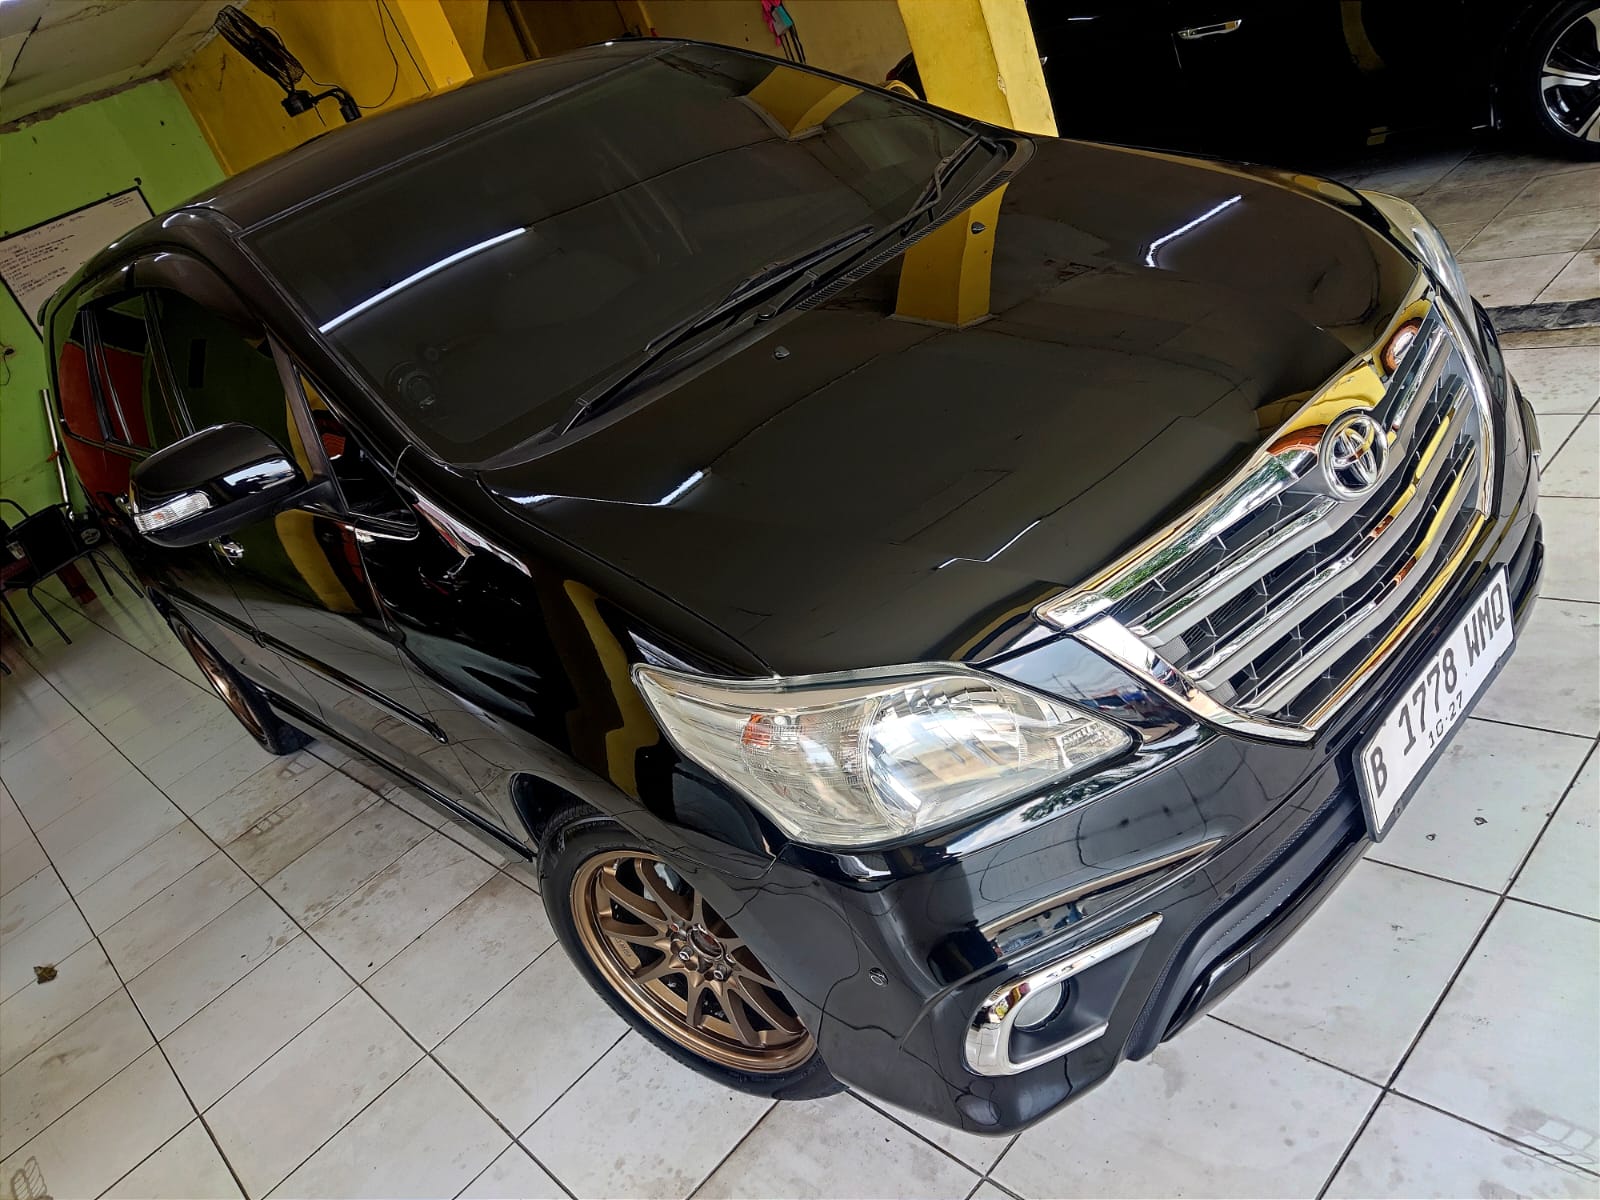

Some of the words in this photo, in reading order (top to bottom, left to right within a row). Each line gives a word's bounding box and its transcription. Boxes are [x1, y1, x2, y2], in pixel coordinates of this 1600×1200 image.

[1370, 746, 1388, 798] B
[1398, 647, 1458, 756] 1778
[1463, 582, 1506, 667] WMQ
